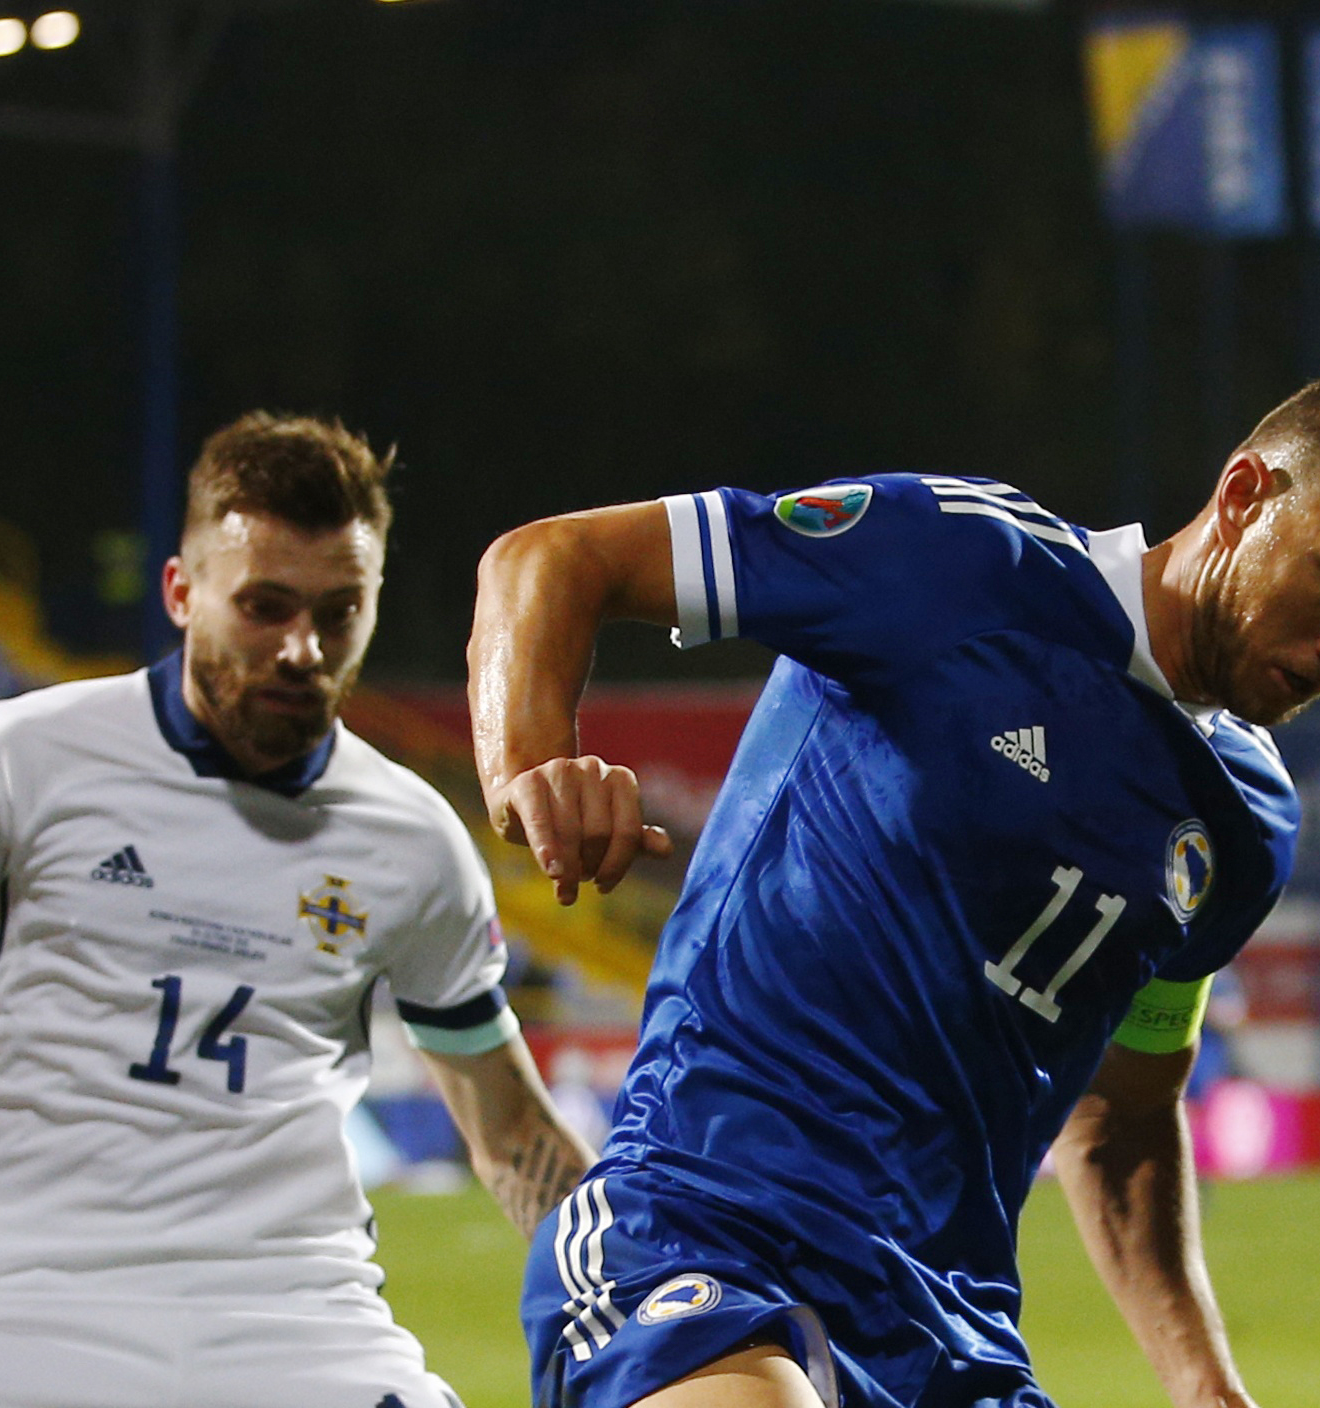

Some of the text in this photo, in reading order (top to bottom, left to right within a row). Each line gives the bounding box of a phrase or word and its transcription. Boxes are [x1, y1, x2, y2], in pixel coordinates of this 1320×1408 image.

[990, 735, 1051, 783] adidas
[90, 867, 155, 888] adidas
[984, 865, 1127, 1024] 11
[128, 974, 256, 1094] 14
